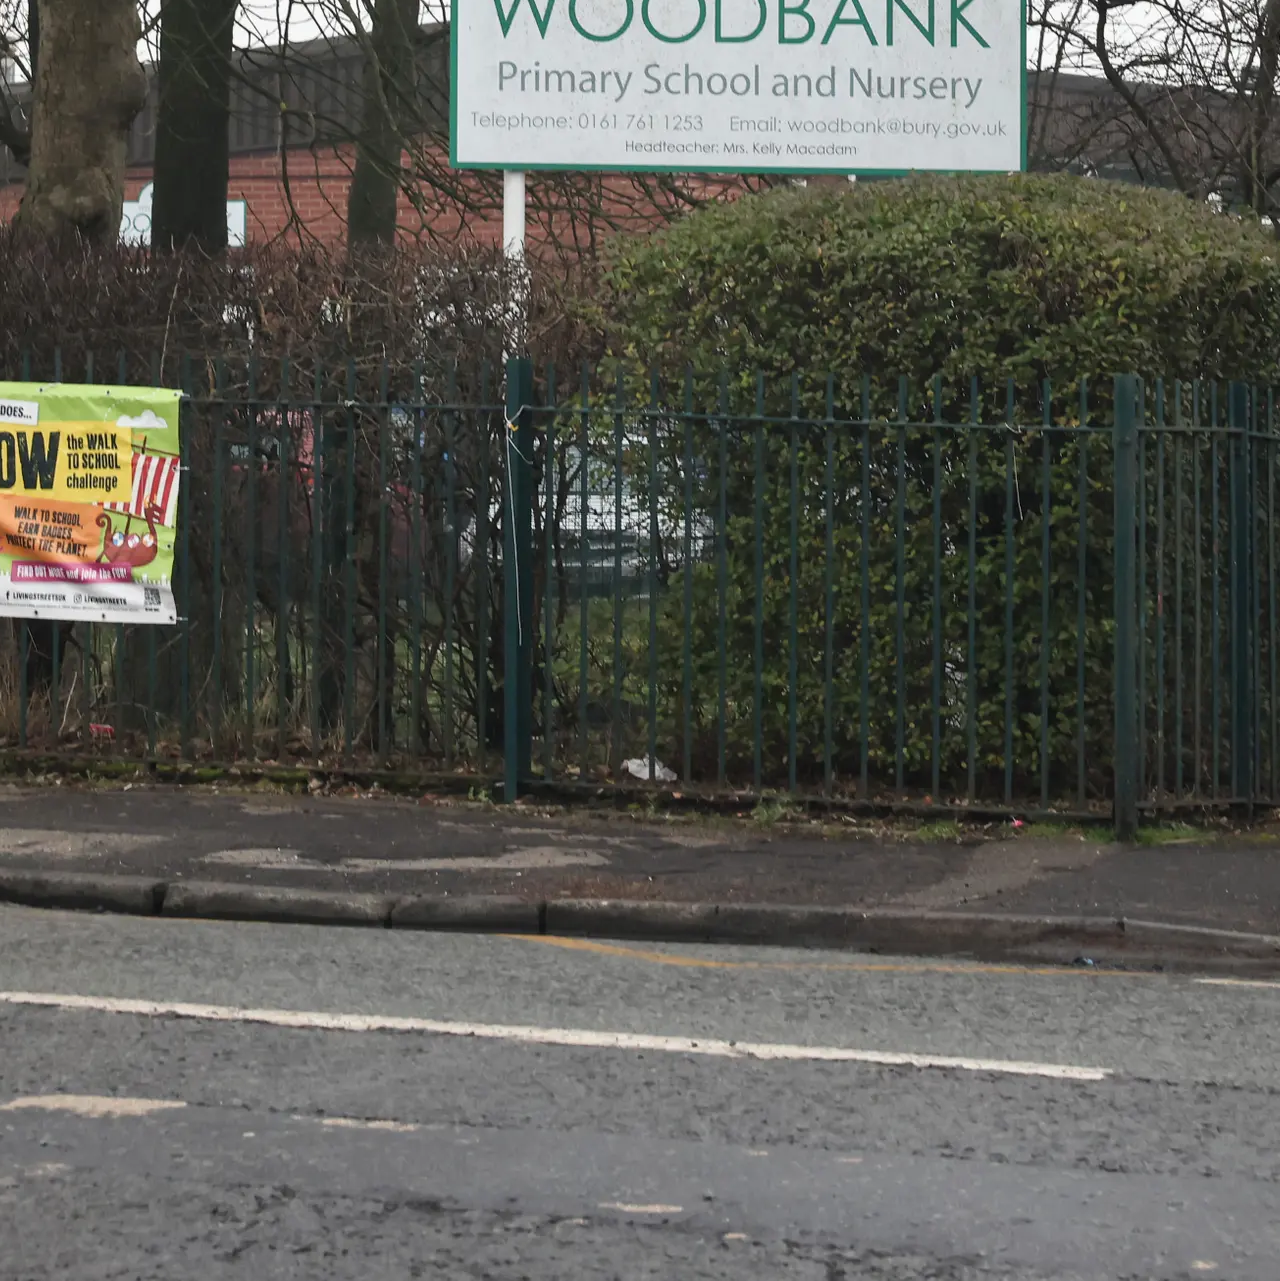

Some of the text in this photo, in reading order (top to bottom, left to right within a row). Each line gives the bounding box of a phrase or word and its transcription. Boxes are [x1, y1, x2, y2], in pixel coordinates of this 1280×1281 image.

[497, 60, 983, 108] Primary School and Nursery
[471, 111, 1007, 138] Telephone: 0161 761 1253 Email: woodbank@bury.gov.uk
[624, 140, 858, 157] Headteacher: Mrs. Kelly Macadam
[0, 404, 32, 419] DOES...
[66, 432, 118, 450] the WALK
[66, 453, 121, 470] TO SCHOOL
[66, 473, 118, 492] challenge
[14, 505, 38, 520] WALK
[40, 509, 50, 523] TO
[17, 521, 40, 537] EARN
[38, 537, 53, 553] THE
[55, 540, 89, 558] PLANET.
